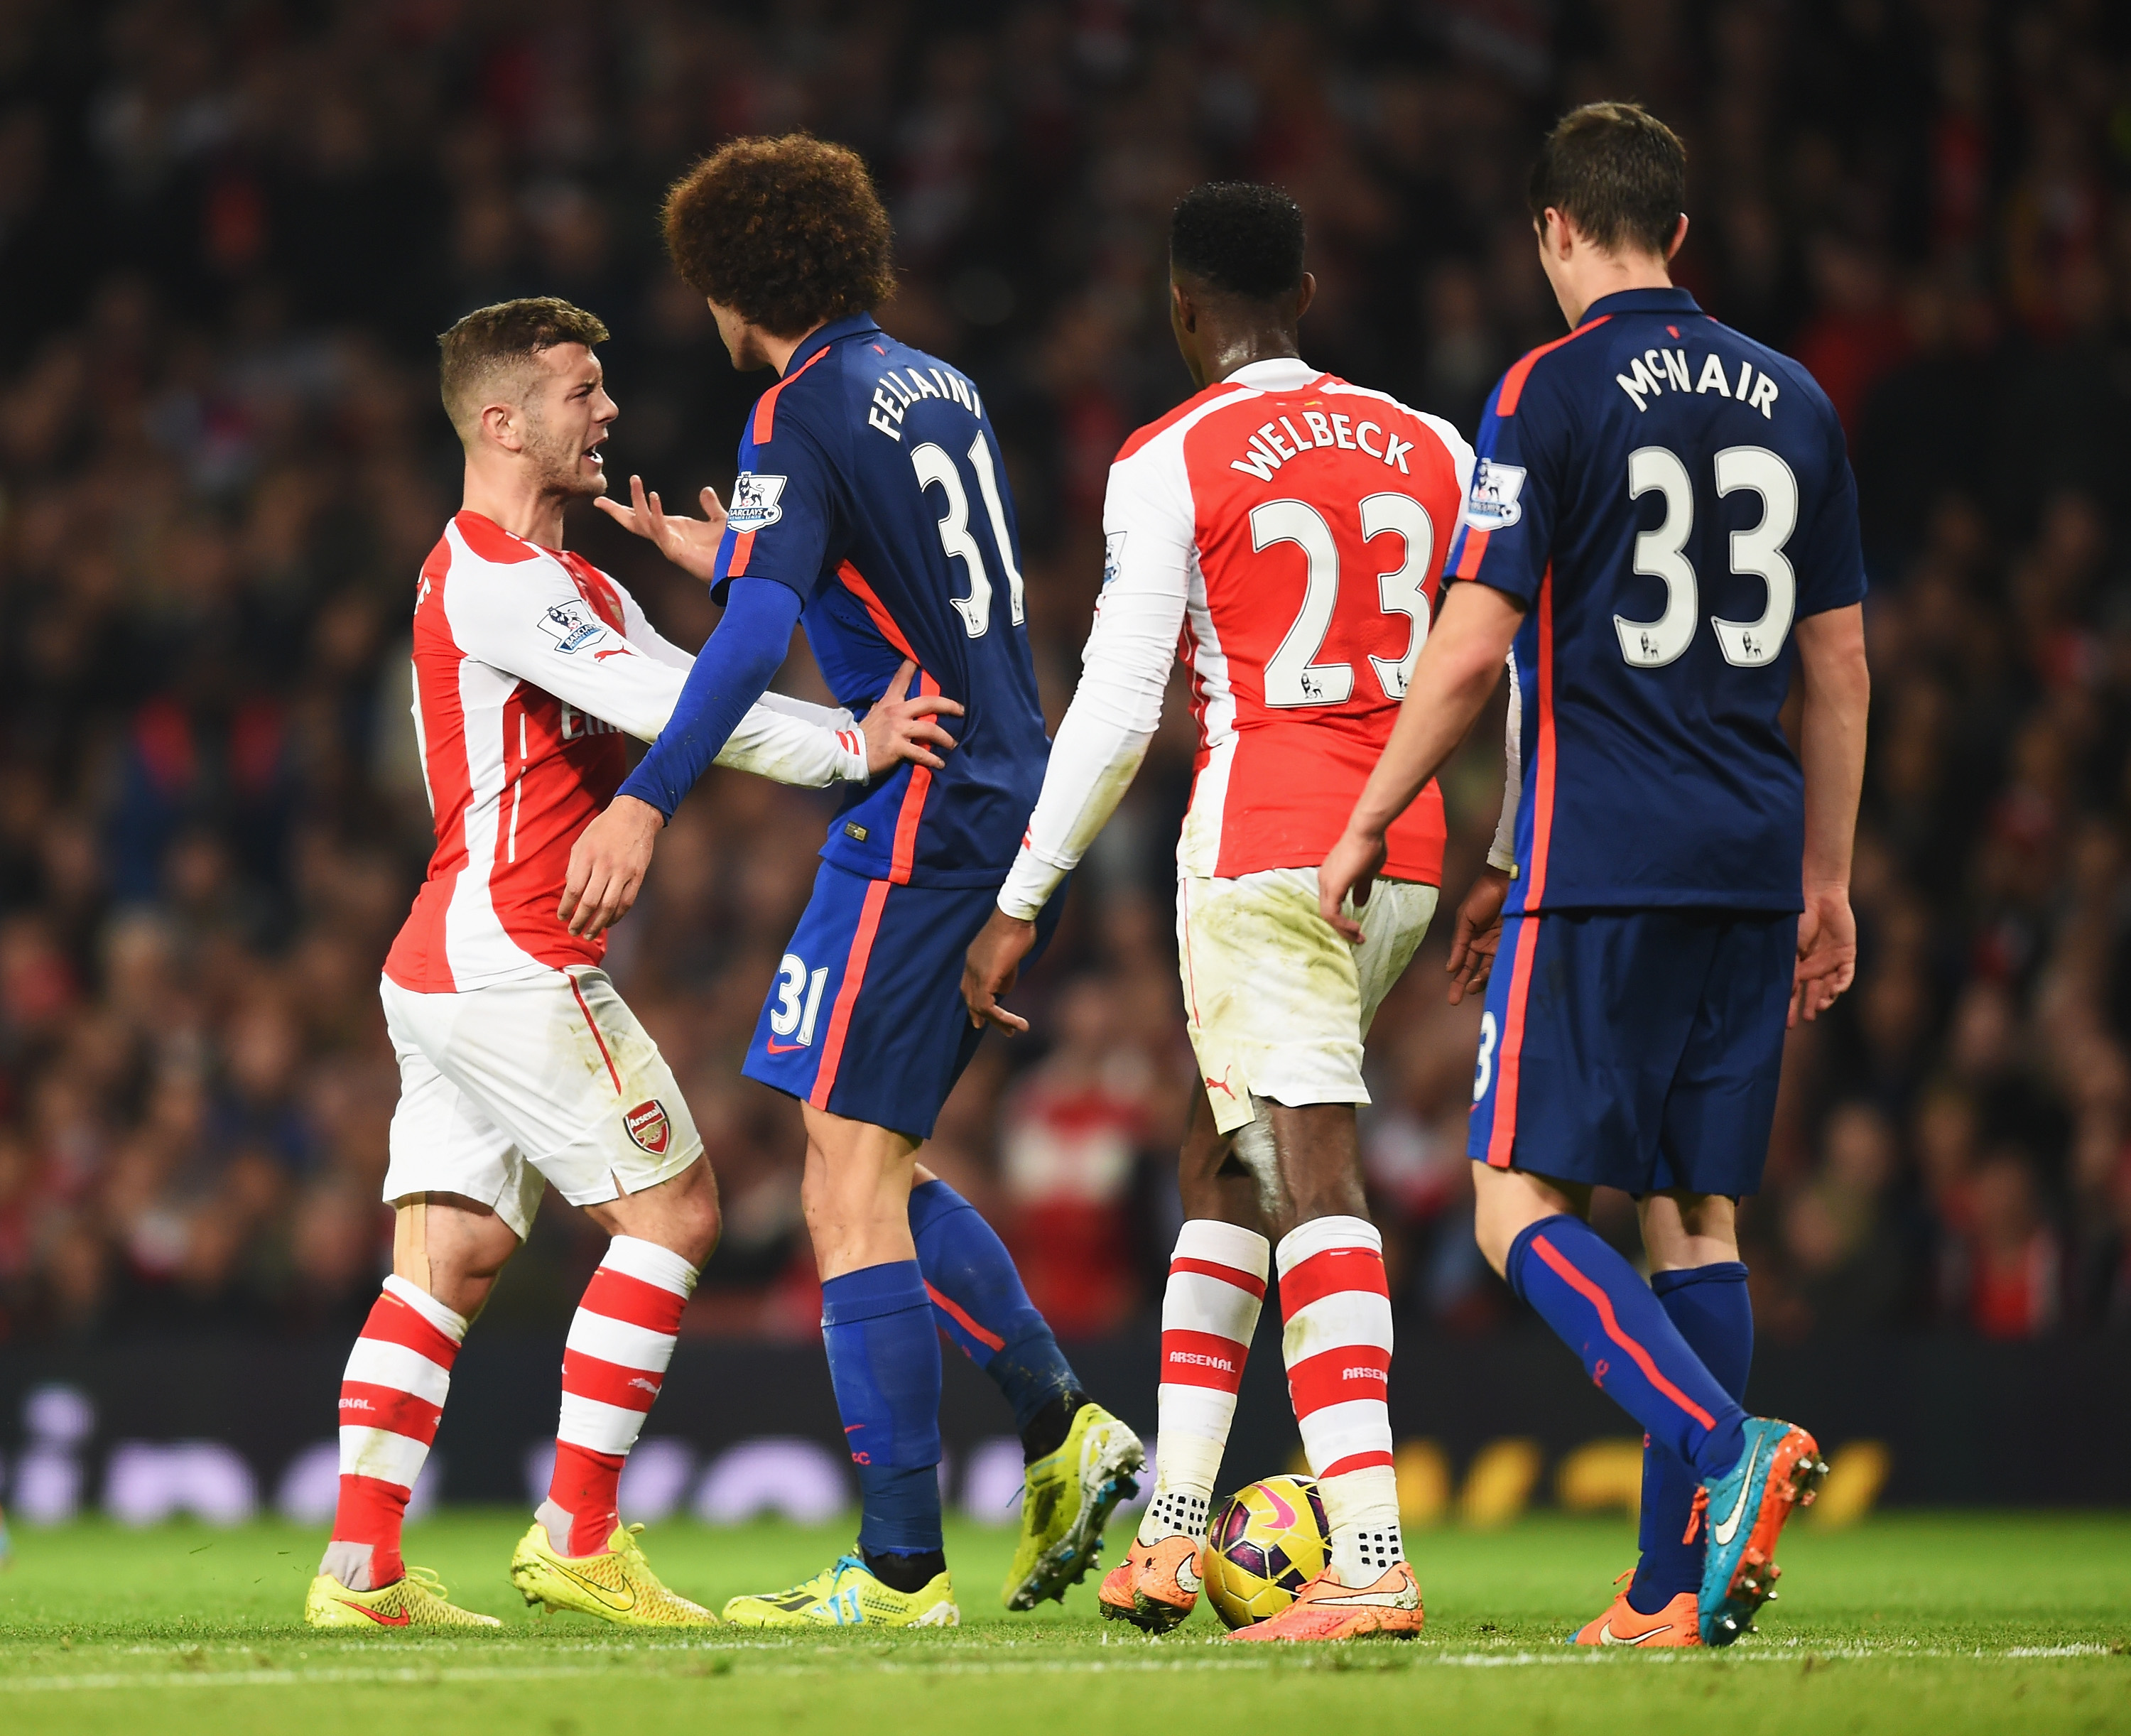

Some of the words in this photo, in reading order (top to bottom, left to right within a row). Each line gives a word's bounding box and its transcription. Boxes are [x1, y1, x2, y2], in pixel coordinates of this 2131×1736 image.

[868, 367, 982, 442] FELLAINI
[1230, 411, 1415, 482] WELBECK
[910, 428, 1025, 639] 31
[1613, 445, 1799, 668] 33
[1248, 491, 1433, 708] 23
[770, 953, 829, 1046] 31
[629, 1106, 661, 1129] Arsenal
[1169, 1351, 1236, 1373] ARSENAL
